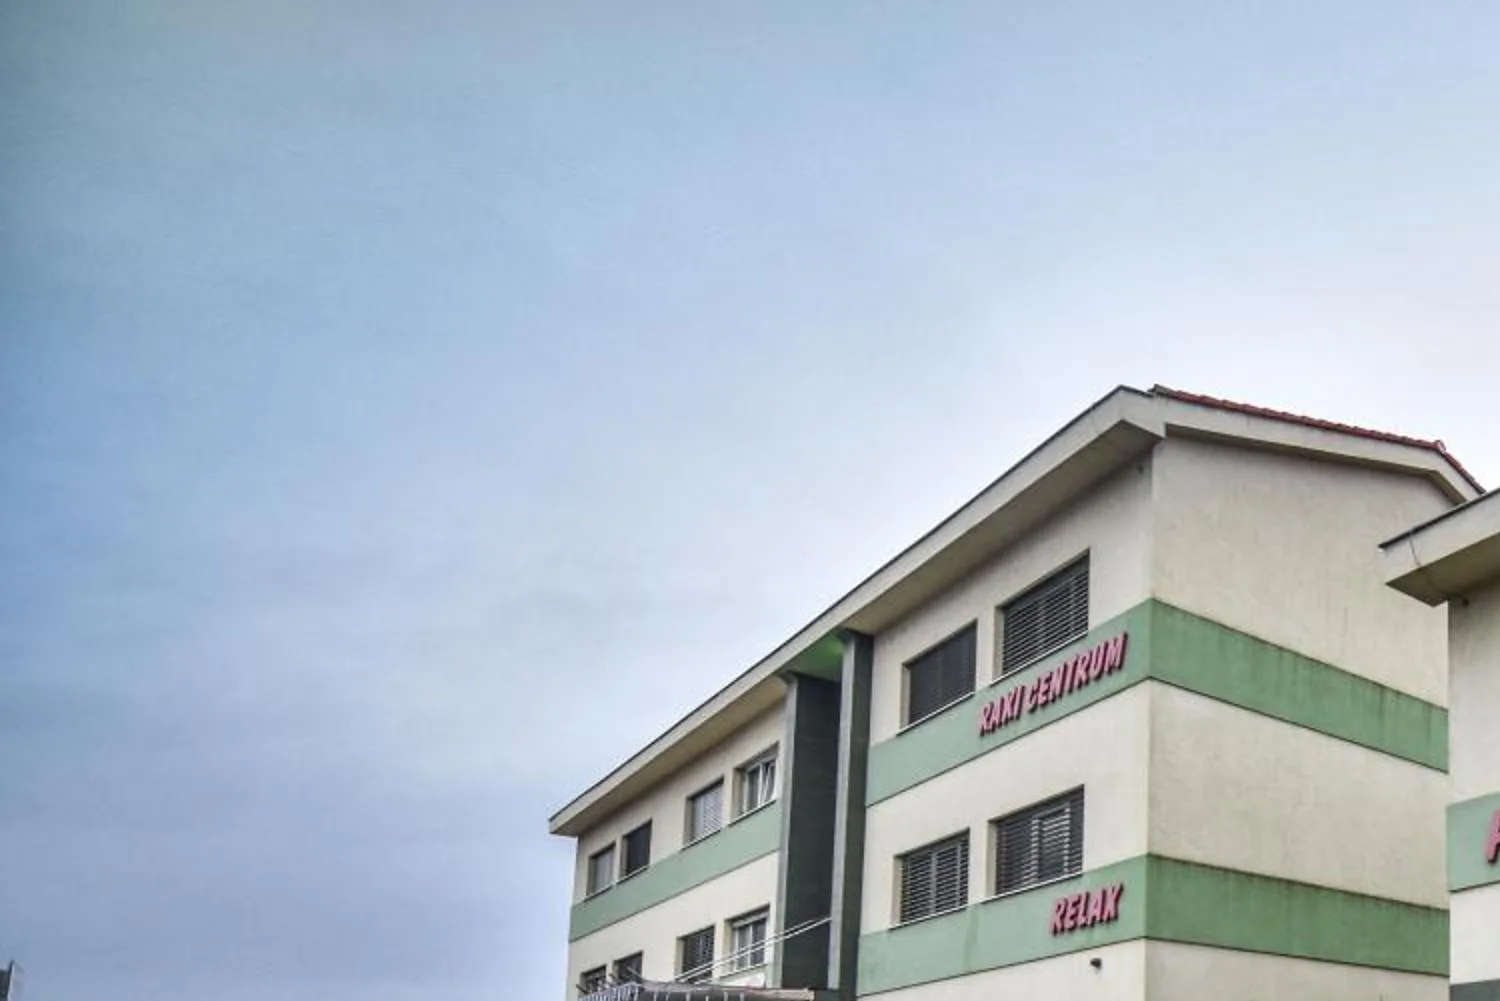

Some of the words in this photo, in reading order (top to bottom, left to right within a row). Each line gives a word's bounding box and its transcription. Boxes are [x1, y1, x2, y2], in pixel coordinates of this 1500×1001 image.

[979, 684, 1026, 737] RAKI
[1027, 631, 1129, 714] CENTRUM
[1050, 883, 1124, 936] RELAX
